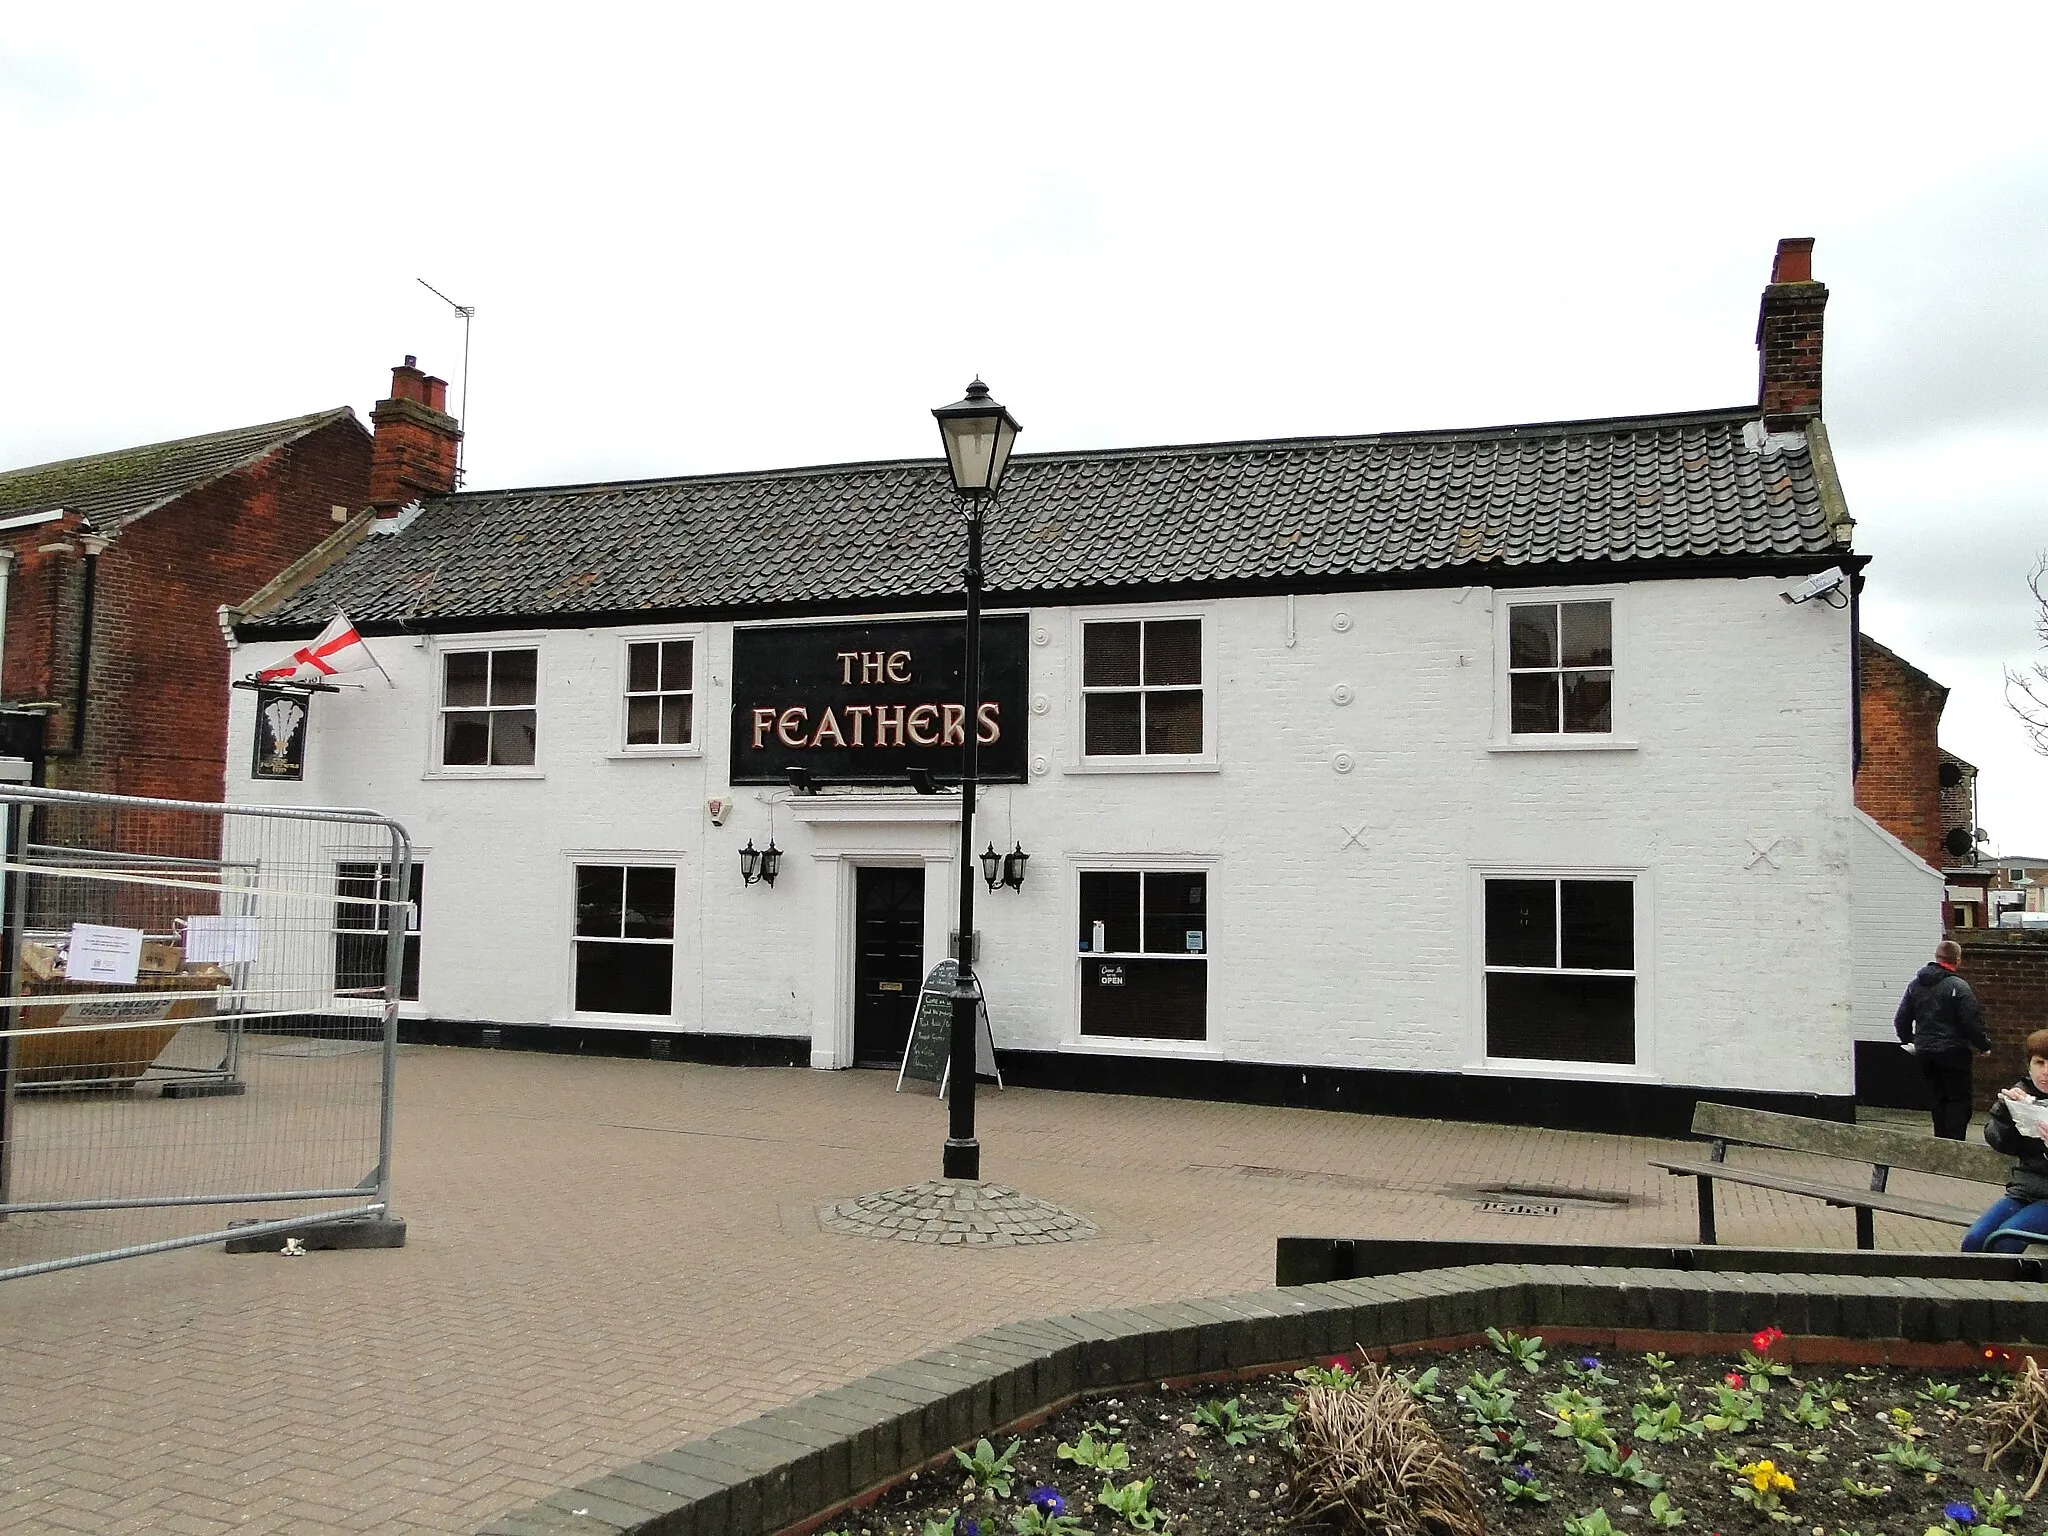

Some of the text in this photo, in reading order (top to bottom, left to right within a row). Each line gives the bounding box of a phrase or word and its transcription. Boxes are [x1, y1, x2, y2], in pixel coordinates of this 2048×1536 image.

[836, 650, 912, 685] THE
[751, 702, 1000, 748] FEATHERS
[1101, 976, 1123, 985] OPEN
